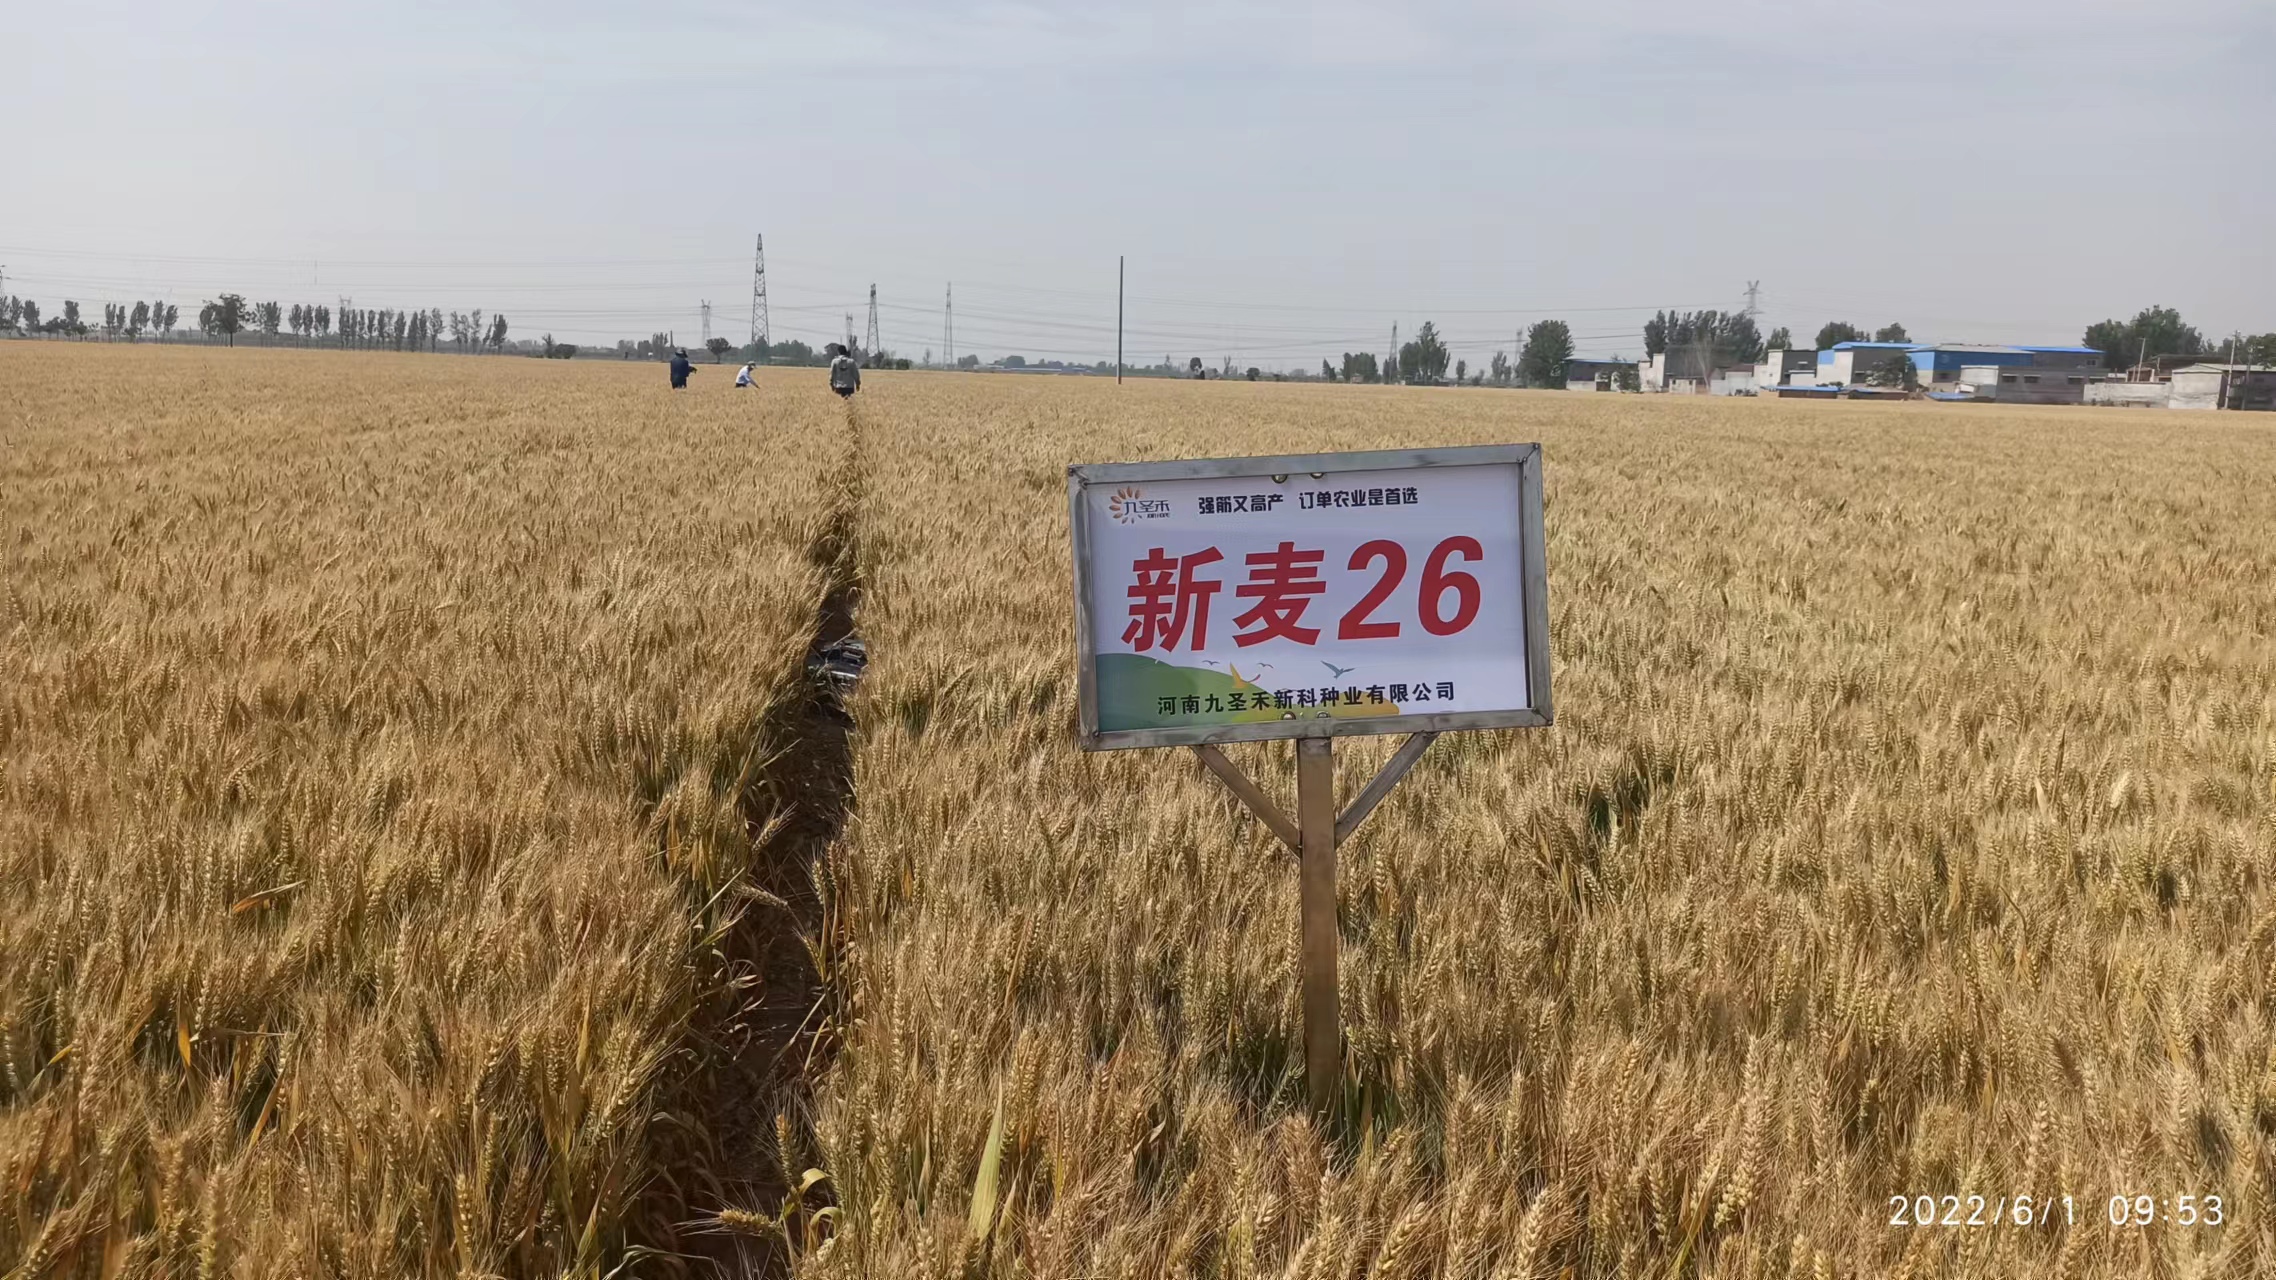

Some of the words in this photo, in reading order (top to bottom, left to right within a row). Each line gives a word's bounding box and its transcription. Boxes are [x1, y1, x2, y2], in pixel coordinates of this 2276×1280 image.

[1124, 500, 1170, 515] 九圣禾
[1198, 493, 1284, 515] 强筋又高产
[1299, 487, 1418, 509] 订单农业是首选
[1121, 535, 1484, 653] 新麦26
[1157, 681, 1456, 716] 河南九圣禾新科种业有限公司
